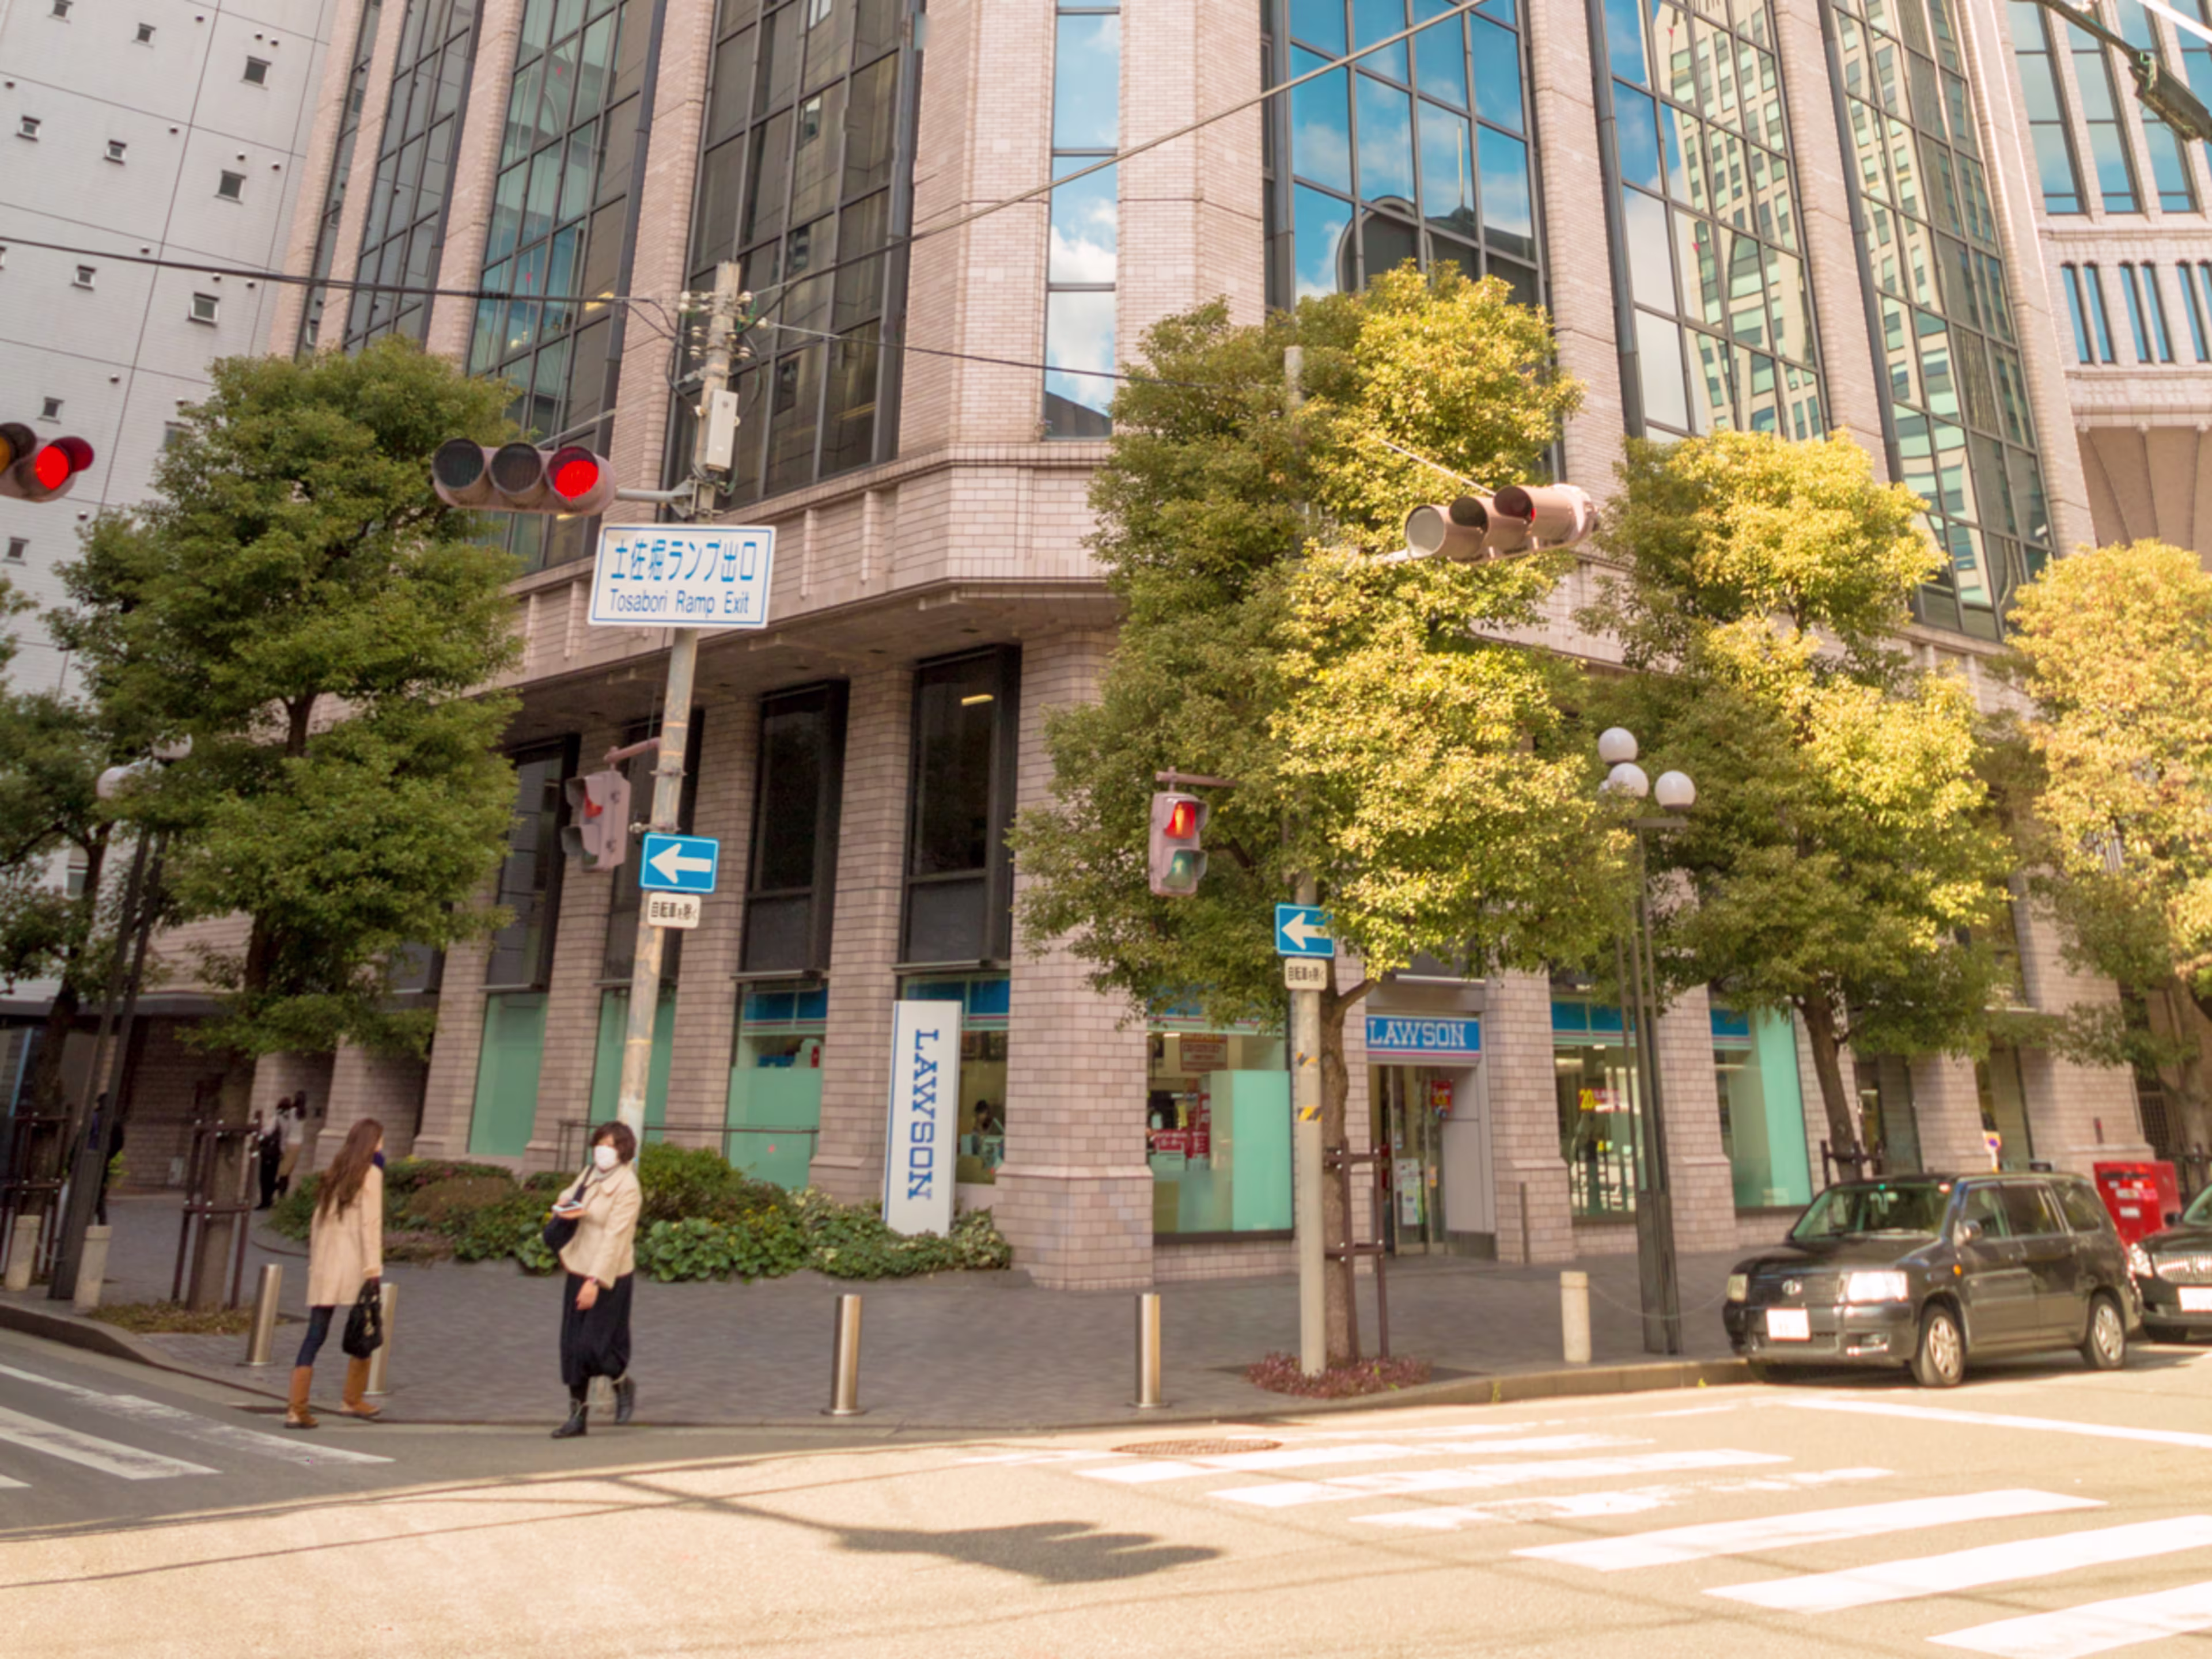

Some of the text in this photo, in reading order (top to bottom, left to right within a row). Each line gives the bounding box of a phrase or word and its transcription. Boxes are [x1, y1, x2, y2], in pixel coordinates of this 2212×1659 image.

[611, 539, 757, 582] 土佐堀ランプ出口
[611, 588, 749, 618] Tosabori Ramp Exit
[1368, 1020, 1467, 1047] LAWSON
[907, 1029, 939, 1200] LAWSON
